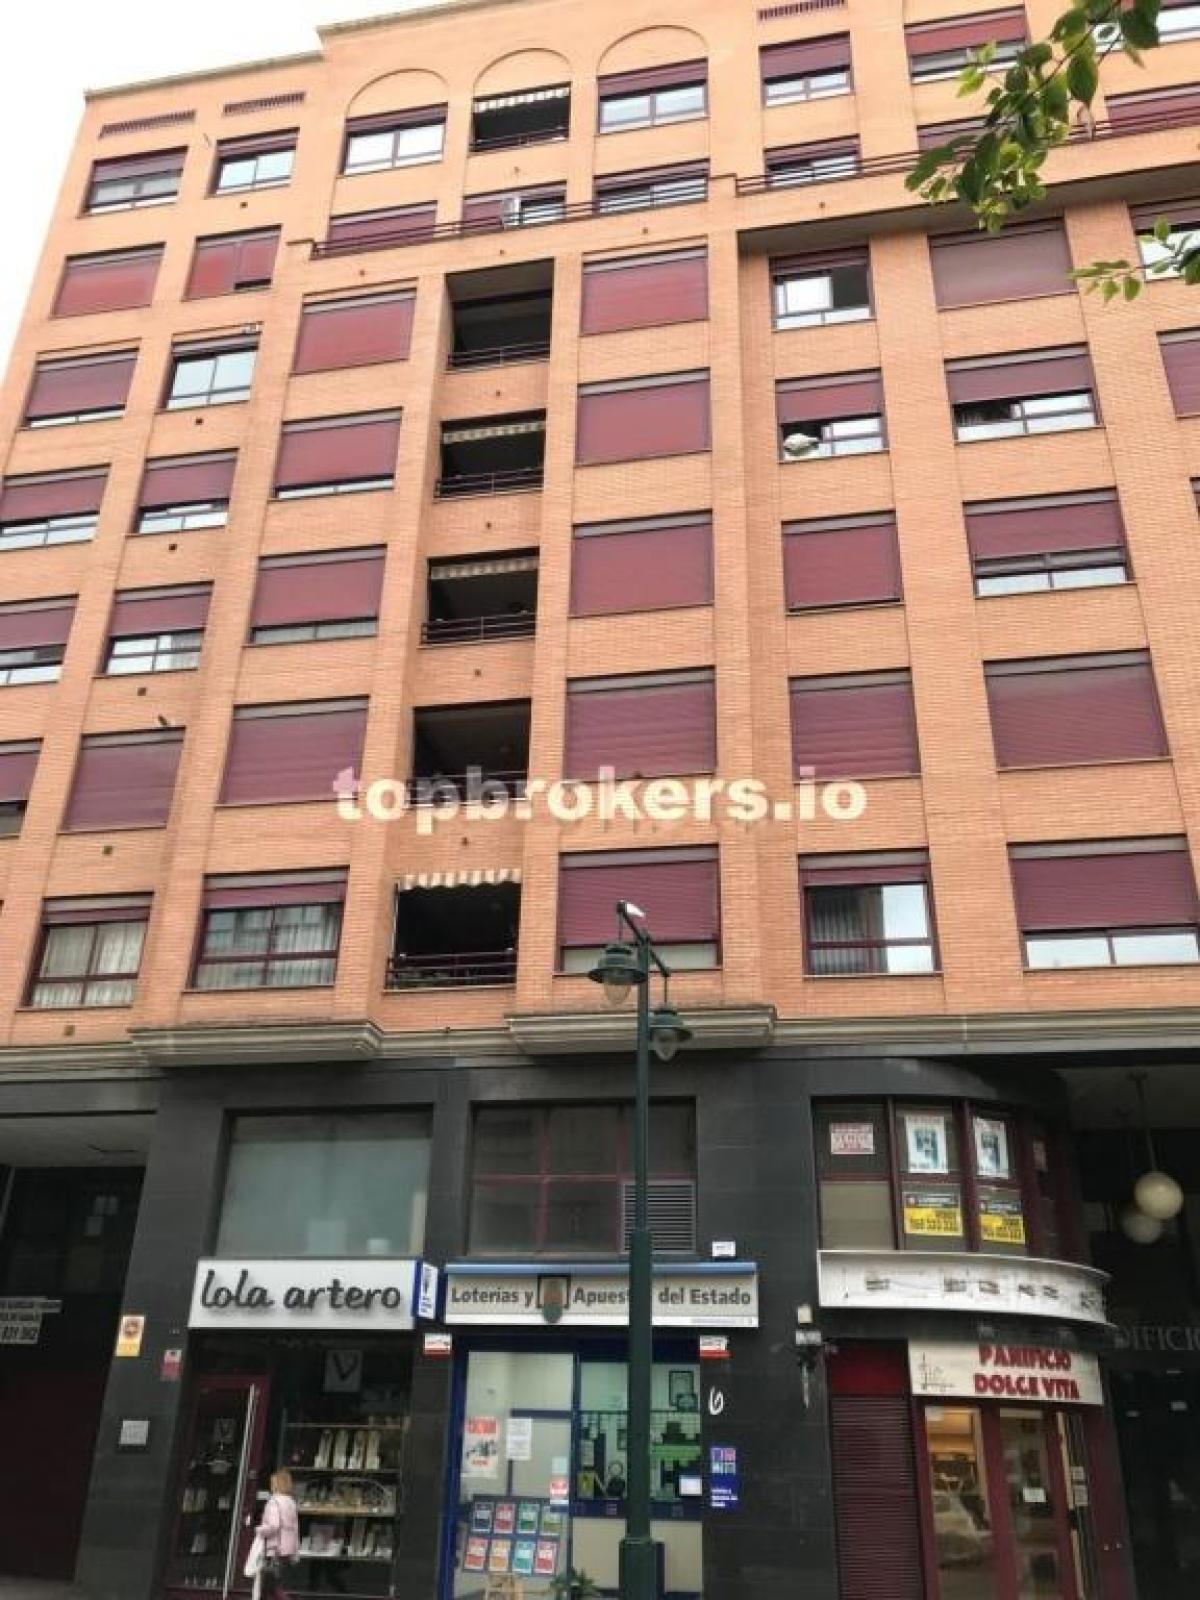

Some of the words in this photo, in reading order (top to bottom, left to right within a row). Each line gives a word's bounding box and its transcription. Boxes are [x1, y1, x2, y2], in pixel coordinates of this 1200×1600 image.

[201, 1268, 274, 1309] lola
[284, 1279, 401, 1310] artero
[525, 1290, 533, 1308] y
[573, 1287, 630, 1308] Apues
[659, 1287, 684, 1304] del
[690, 1288, 751, 1304] Estado
[974, 1373, 1039, 1396] DOLCE
[1041, 1377, 1080, 1399] VITA
